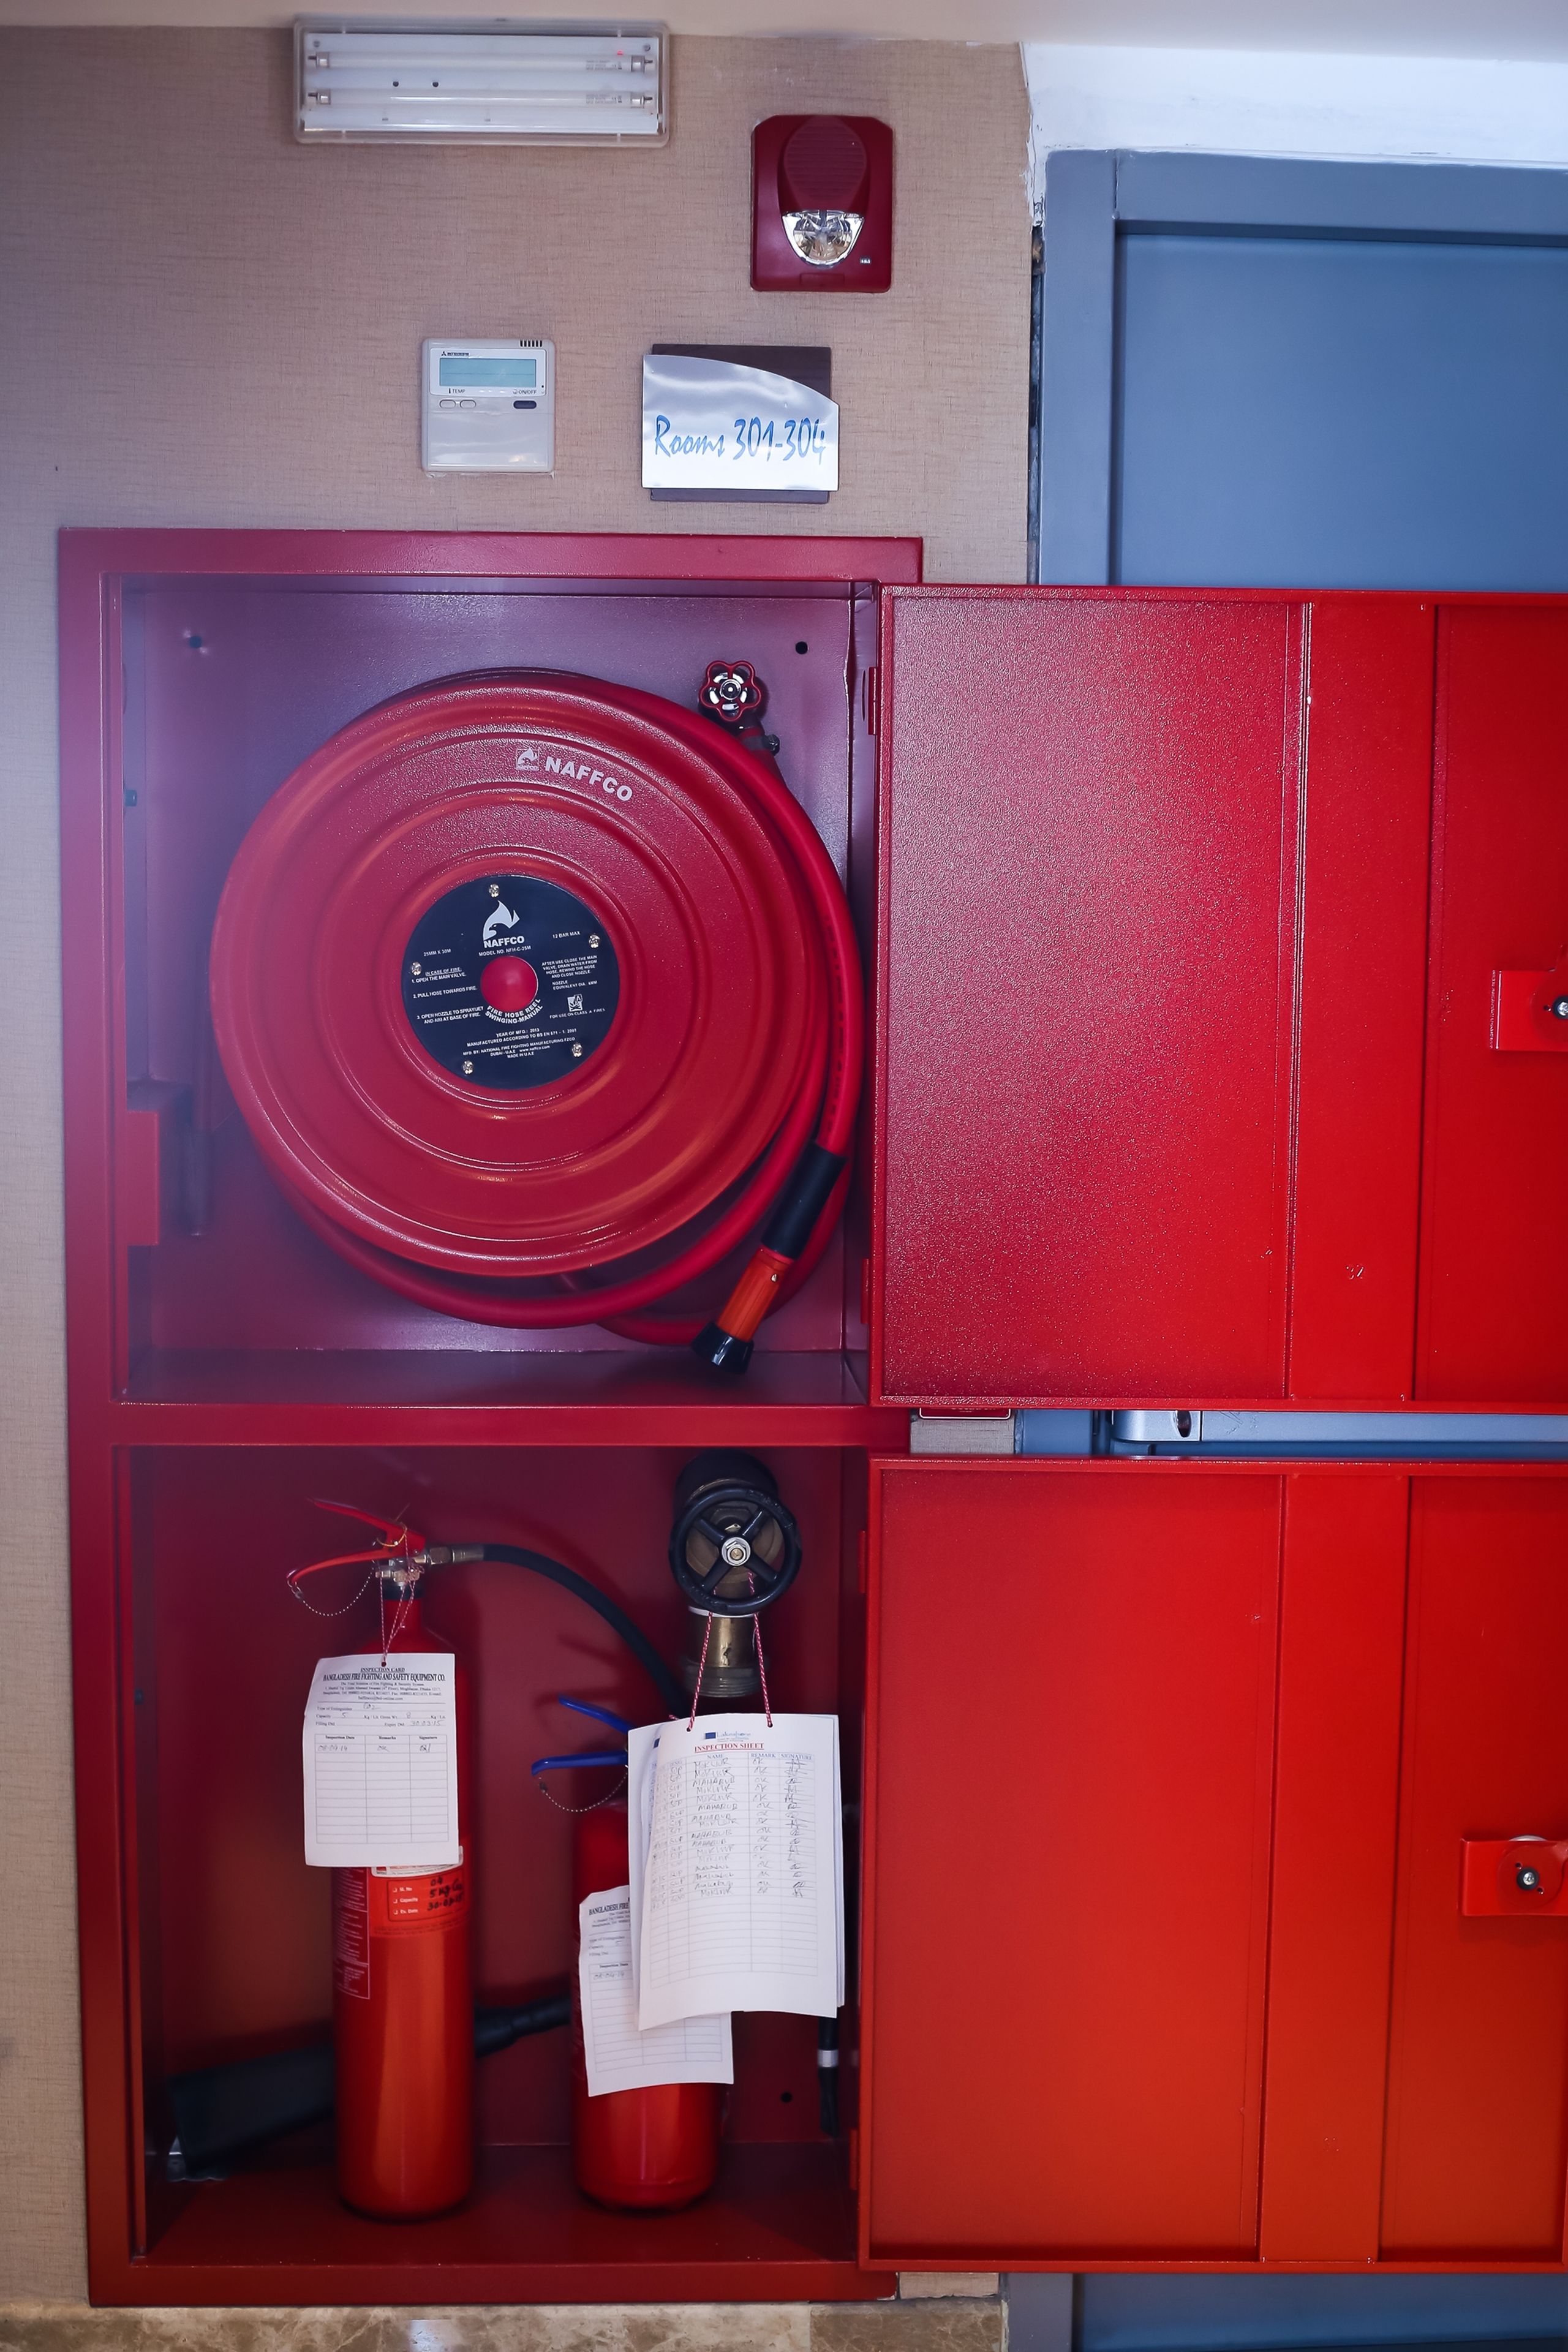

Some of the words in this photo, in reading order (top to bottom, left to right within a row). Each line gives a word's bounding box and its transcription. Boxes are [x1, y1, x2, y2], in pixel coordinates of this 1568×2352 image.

[655, 415, 725, 458] Rooms
[733, 417, 826, 466] 301-304
[545, 756, 633, 801] NAFFCO
[483, 936, 524, 948] NAFFCO
[487, 1005, 503, 1016] FIRE
[525, 999, 540, 1013] REEL
[485, 1006, 543, 1023] SWINGING-MANUAL
[467, 1038, 502, 1047] MANUFACTURED
[410, 1673, 437, 1683] EQUIPMENT
[695, 1743, 738, 1752] INSPECTION
[589, 1904, 618, 1916] BANGLADESH
